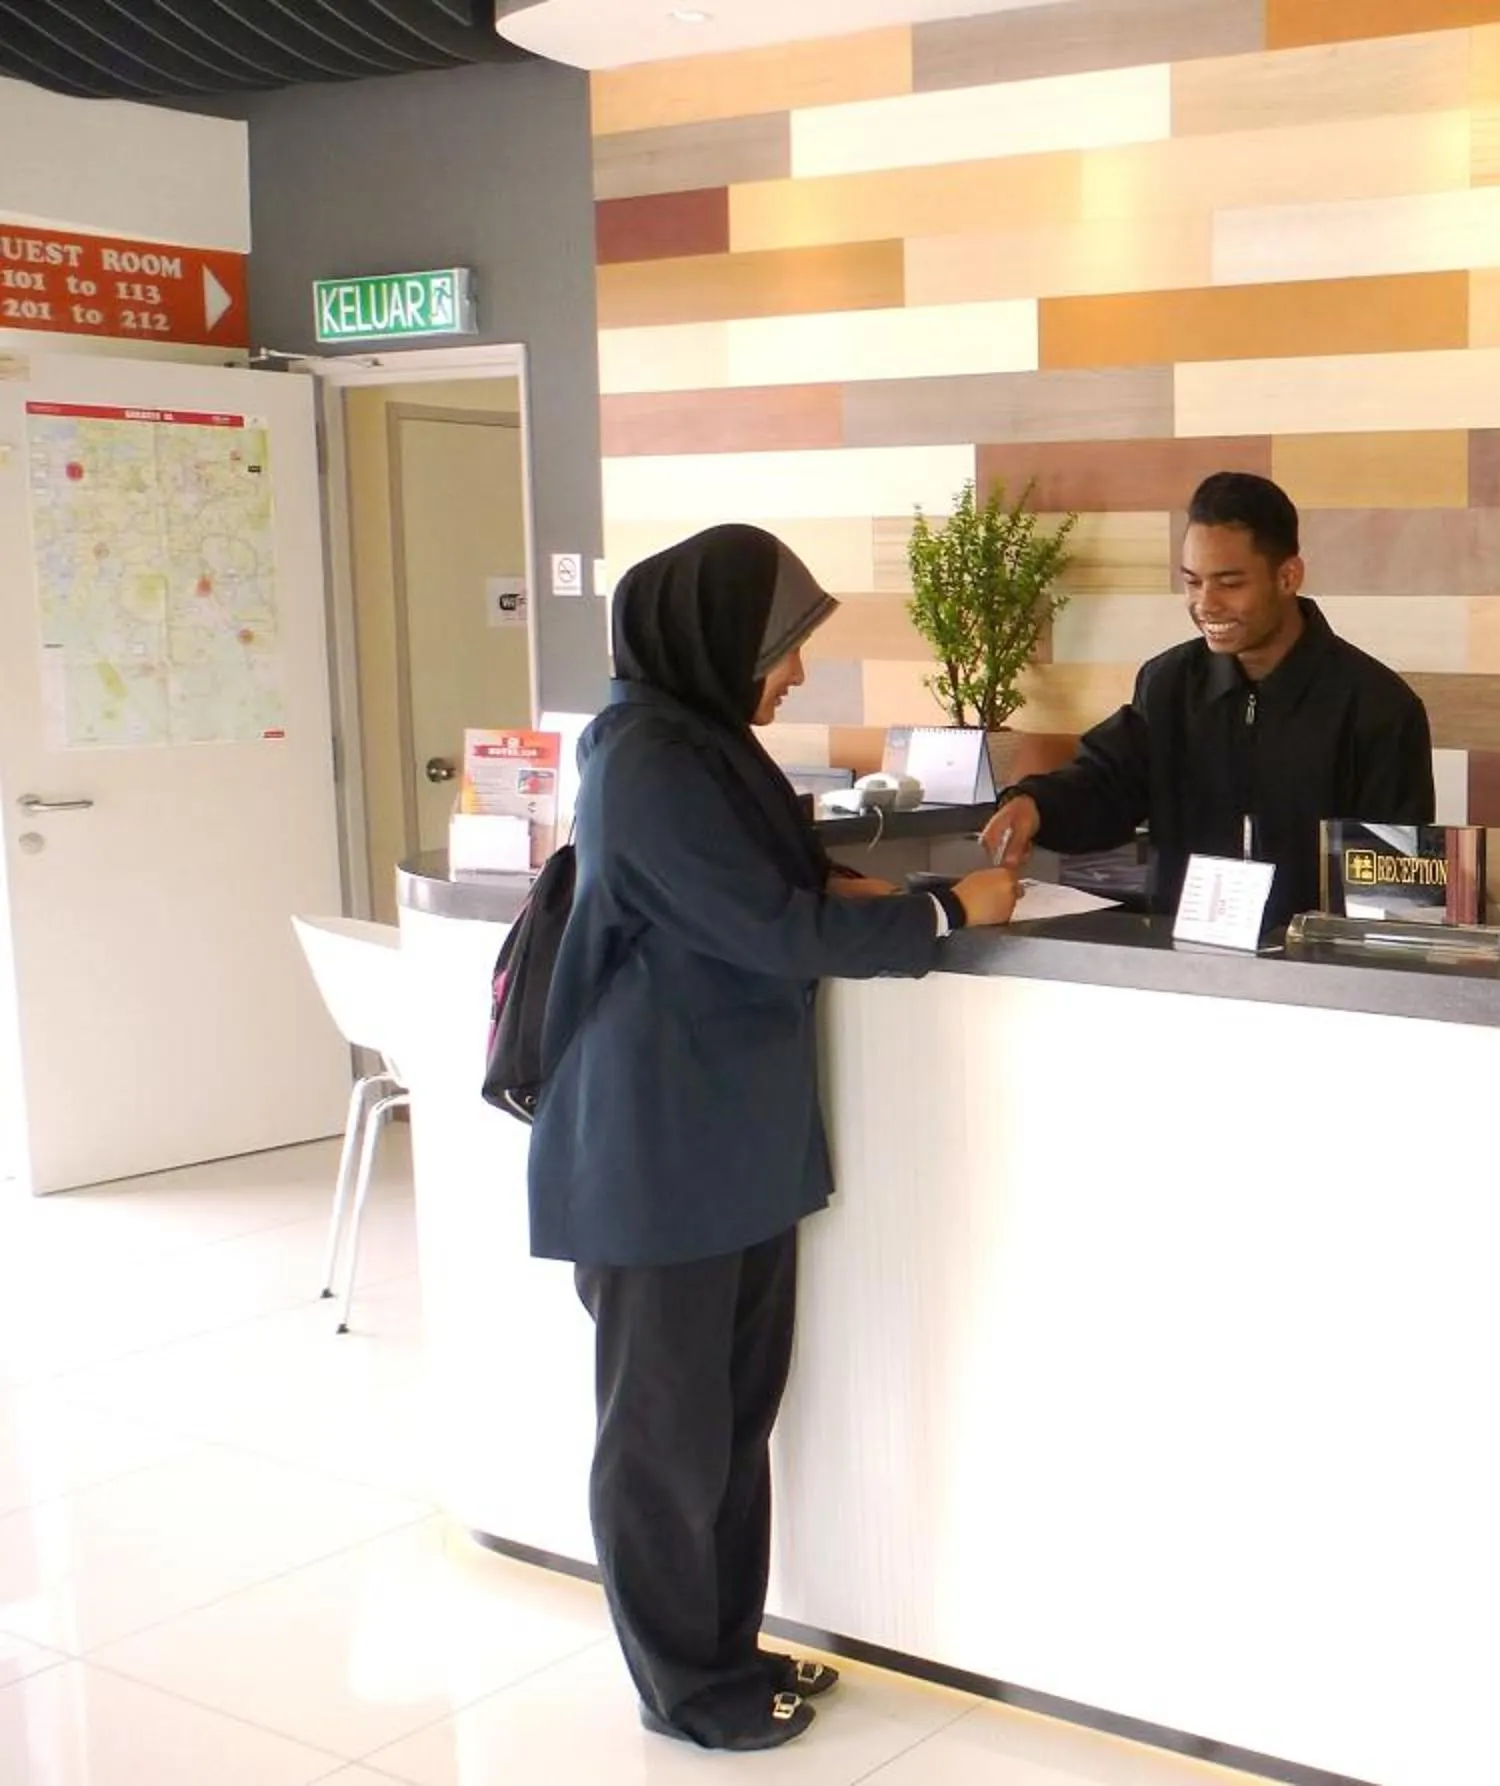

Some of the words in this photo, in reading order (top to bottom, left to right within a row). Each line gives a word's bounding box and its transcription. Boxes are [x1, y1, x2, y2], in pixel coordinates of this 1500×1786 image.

[0, 237, 83, 267] UEST
[101, 249, 182, 279] ROOM
[3, 270, 46, 291] 101
[66, 275, 97, 297] to
[115, 281, 161, 305] 113
[3, 298, 51, 321] 201
[72, 304, 103, 325] to
[121, 310, 170, 331] 212
[321, 280, 426, 334] KELUAR
[1377, 855, 1448, 884] RECEPTION
